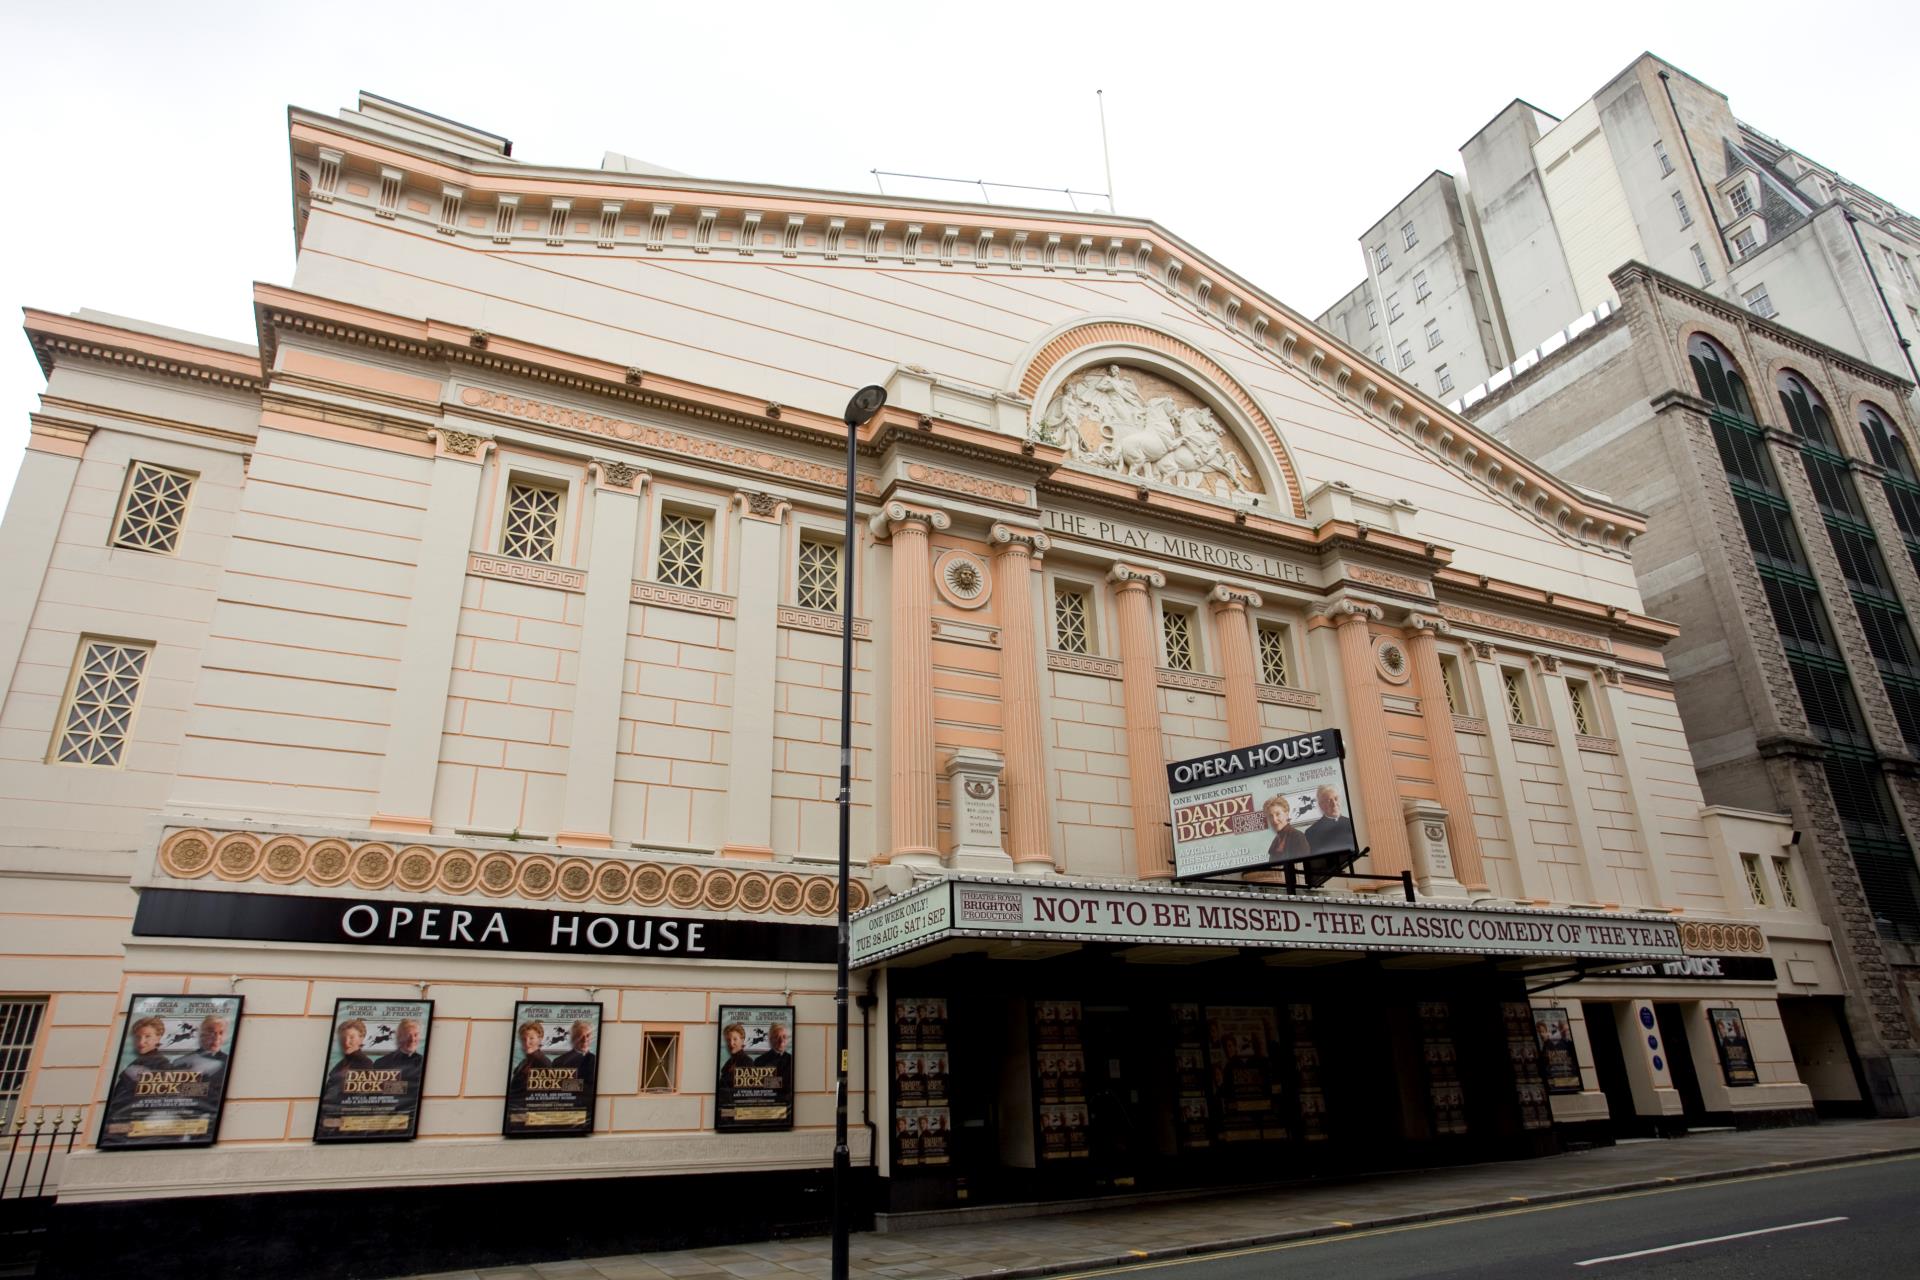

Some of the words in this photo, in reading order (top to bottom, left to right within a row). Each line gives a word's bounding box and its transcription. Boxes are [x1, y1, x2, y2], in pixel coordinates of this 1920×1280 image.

[1046, 511, 1088, 536] THE
[1099, 521, 1150, 549] PLAY
[1163, 536, 1254, 572] MIRRORS
[1264, 559, 1308, 584] LIFE
[1174, 753, 1246, 784] OPERA
[1248, 735, 1326, 768] HOUSE
[1173, 795, 1192, 806] ONE
[1193, 789, 1220, 802] WEEK
[1220, 784, 1248, 798] ONLY!
[1176, 795, 1252, 826] DANDY
[1178, 816, 1232, 842] DICK
[963, 892, 996, 901] THEATRE
[963, 900, 1021, 912] BRIGHTON
[869, 916, 883, 931] ONE
[884, 906, 905, 923] WEEK
[906, 897, 929, 915] ONLY!
[963, 910, 1023, 921] PRODUCTIONS
[342, 904, 510, 944] OPERA
[550, 915, 706, 952] HOUSE
[1033, 897, 1100, 923] NOT
[1107, 901, 1147, 925] TO
[1152, 903, 1190, 928] BE
[1197, 906, 1301, 932] MISSED
[1313, 912, 1366, 936] THE
[1370, 914, 1464, 939] CLASSIC
[1468, 919, 1553, 943] COMEDY
[1557, 924, 1582, 944] OF
[1586, 926, 1626, 946] THE
[1626, 928, 1680, 948] YEAR
[856, 934, 872, 952] TUE
[872, 931, 882, 946] 28
[882, 924, 899, 943] AUG
[905, 918, 921, 935] SAT
[923, 914, 927, 928] 1
[928, 908, 945, 927] SEP
[1663, 957, 1725, 976] HOUSE
[140, 1071, 201, 1083] DANDY
[347, 1070, 401, 1081] DANDY
[529, 1069, 577, 1080] DANDY
[735, 1067, 777, 1077] DANDY
[136, 1082, 180, 1095] DICK
[345, 1080, 382, 1092] DICK
[528, 1079, 561, 1089] DICK
[734, 1077, 764, 1087] DICK
